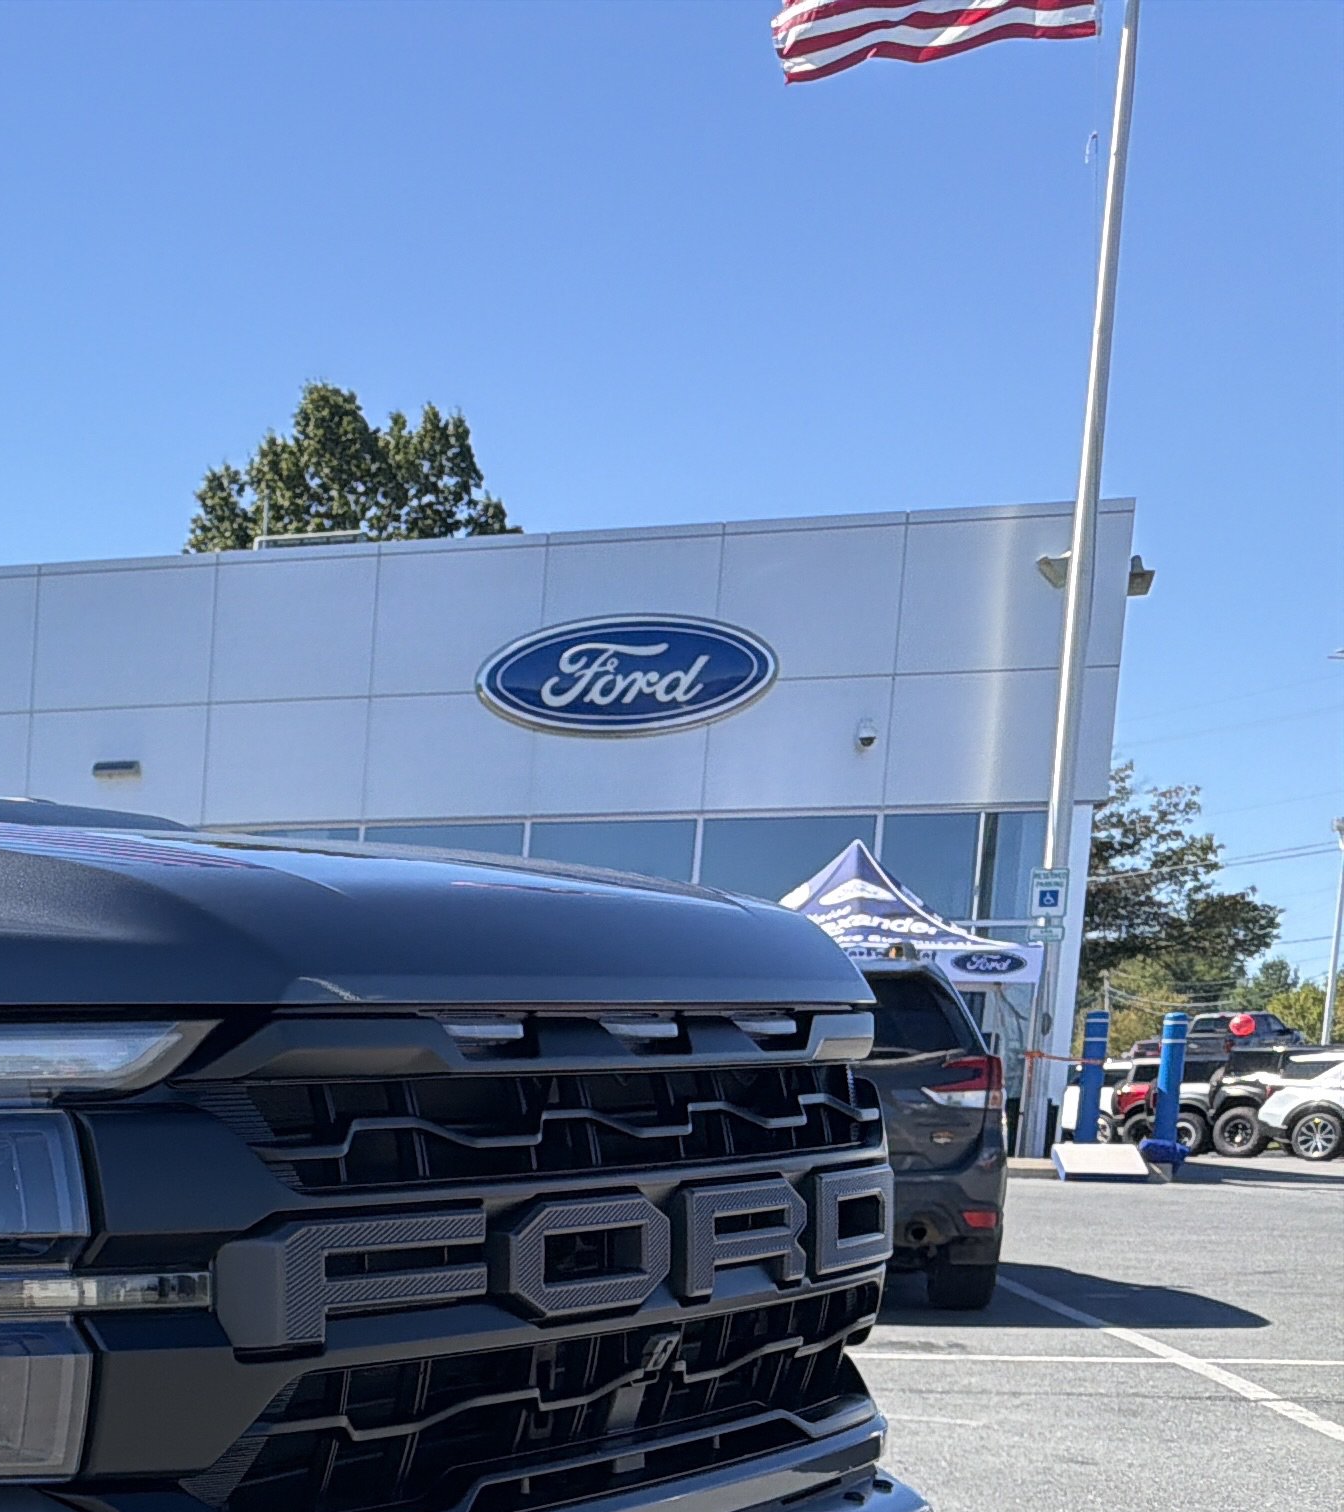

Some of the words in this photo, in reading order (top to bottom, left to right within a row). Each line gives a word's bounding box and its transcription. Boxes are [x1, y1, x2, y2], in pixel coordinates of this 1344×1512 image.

[540, 642, 710, 708] Ford
[966, 953, 1012, 972] Ford
[220, 1163, 895, 1351] FORD
